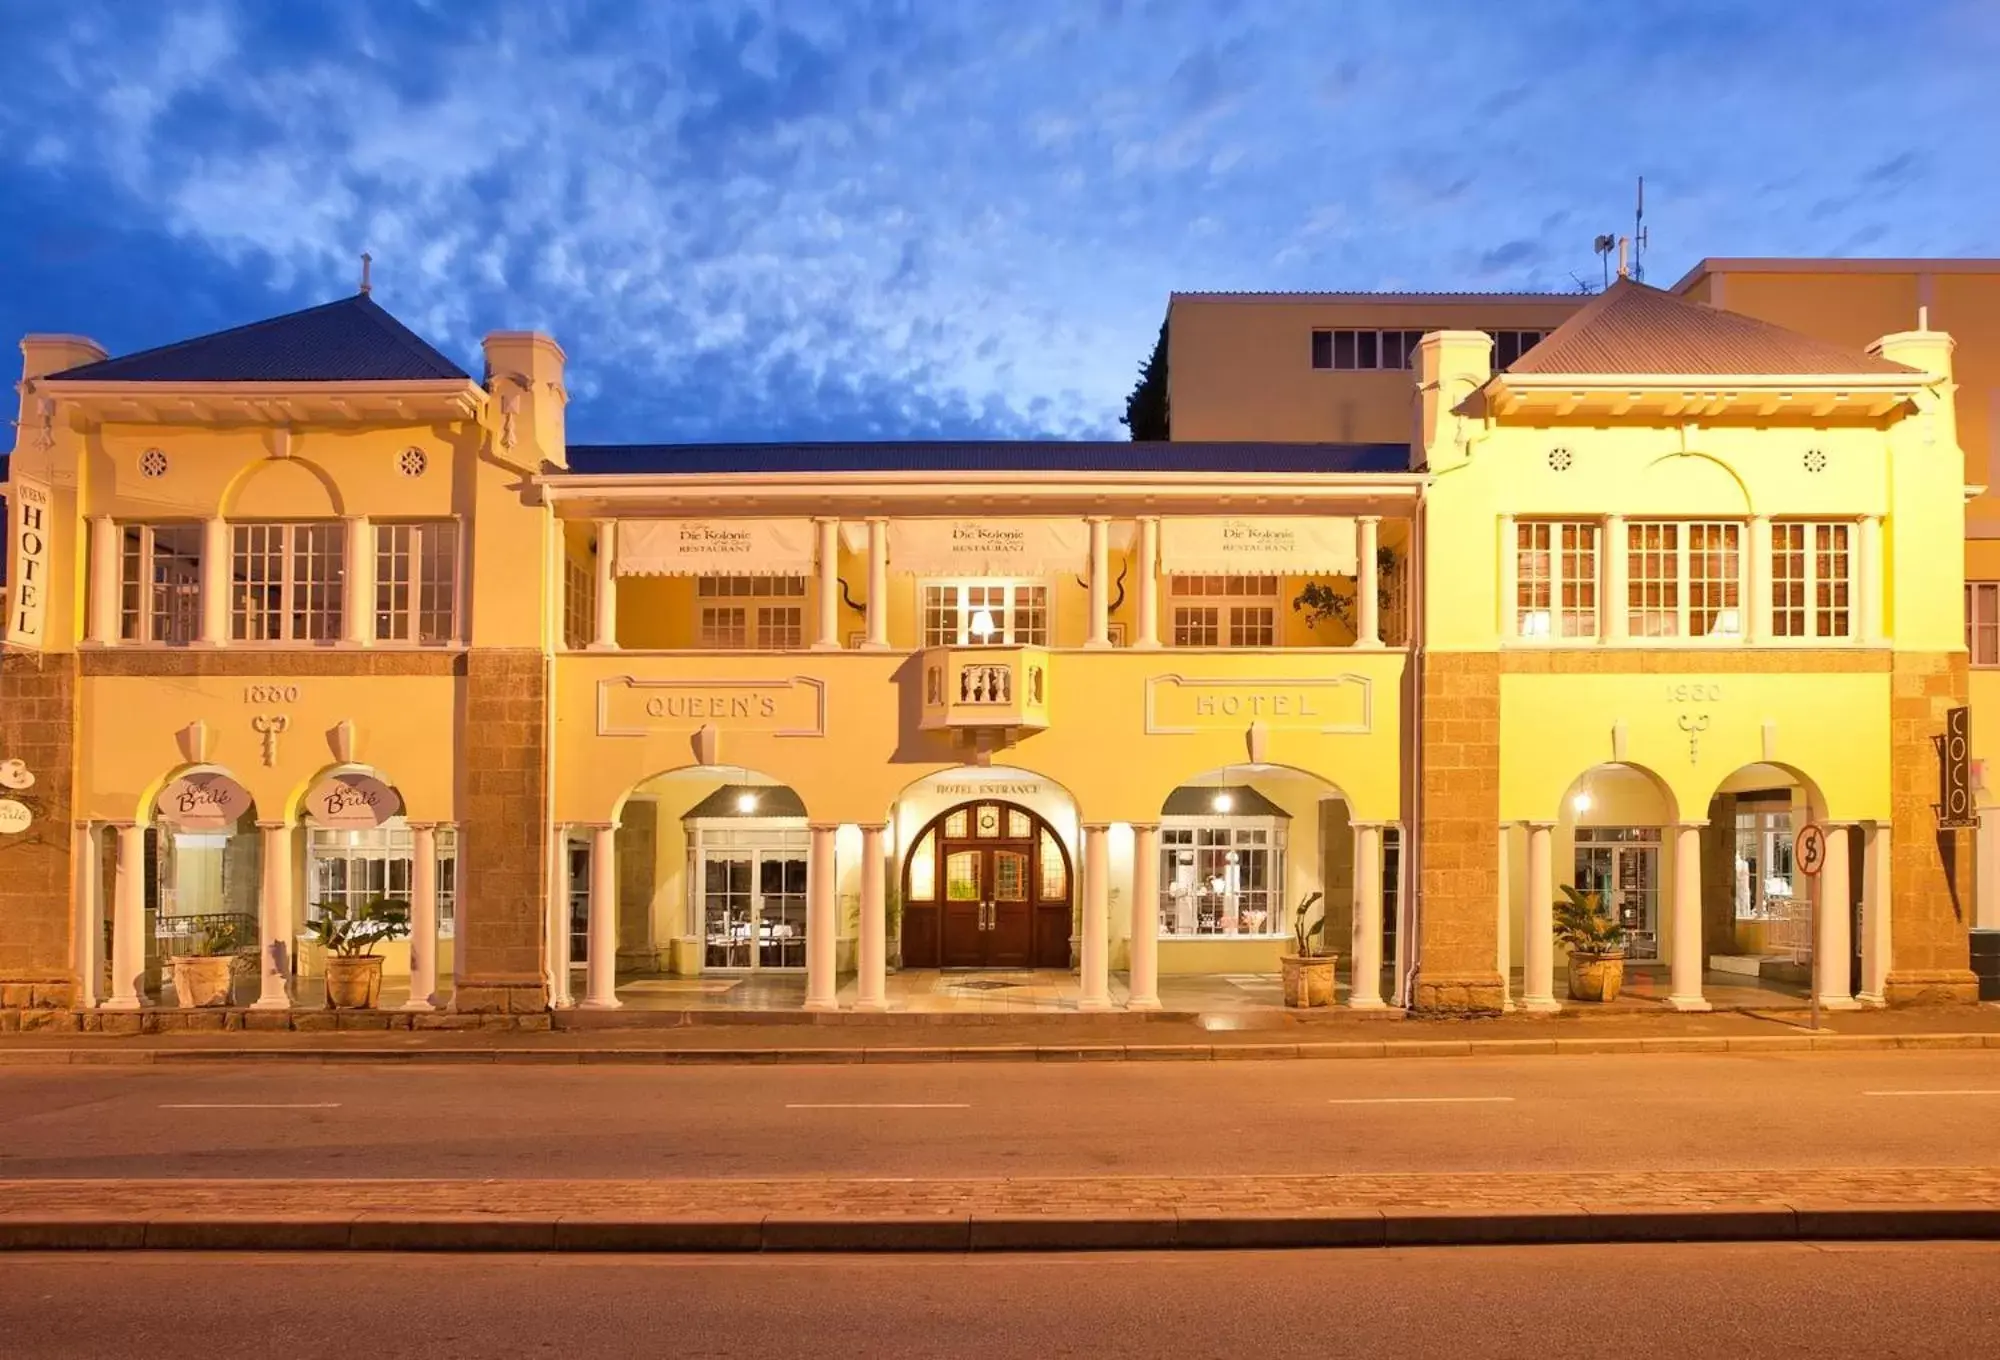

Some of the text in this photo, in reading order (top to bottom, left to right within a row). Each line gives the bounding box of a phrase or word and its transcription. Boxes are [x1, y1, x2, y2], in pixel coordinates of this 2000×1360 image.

[19, 484, 47, 504] QUEENS
[679, 545, 751, 553] RESTAURANT
[952, 545, 1024, 553] RESTAURANT
[17, 503, 43, 635] HOTEL
[645, 693, 775, 718] QUEEN'S
[1196, 694, 1318, 716] HOTEL
[1950, 709, 1967, 814] COCO
[936, 784, 1041, 795] HOTEL ENTRANCE
